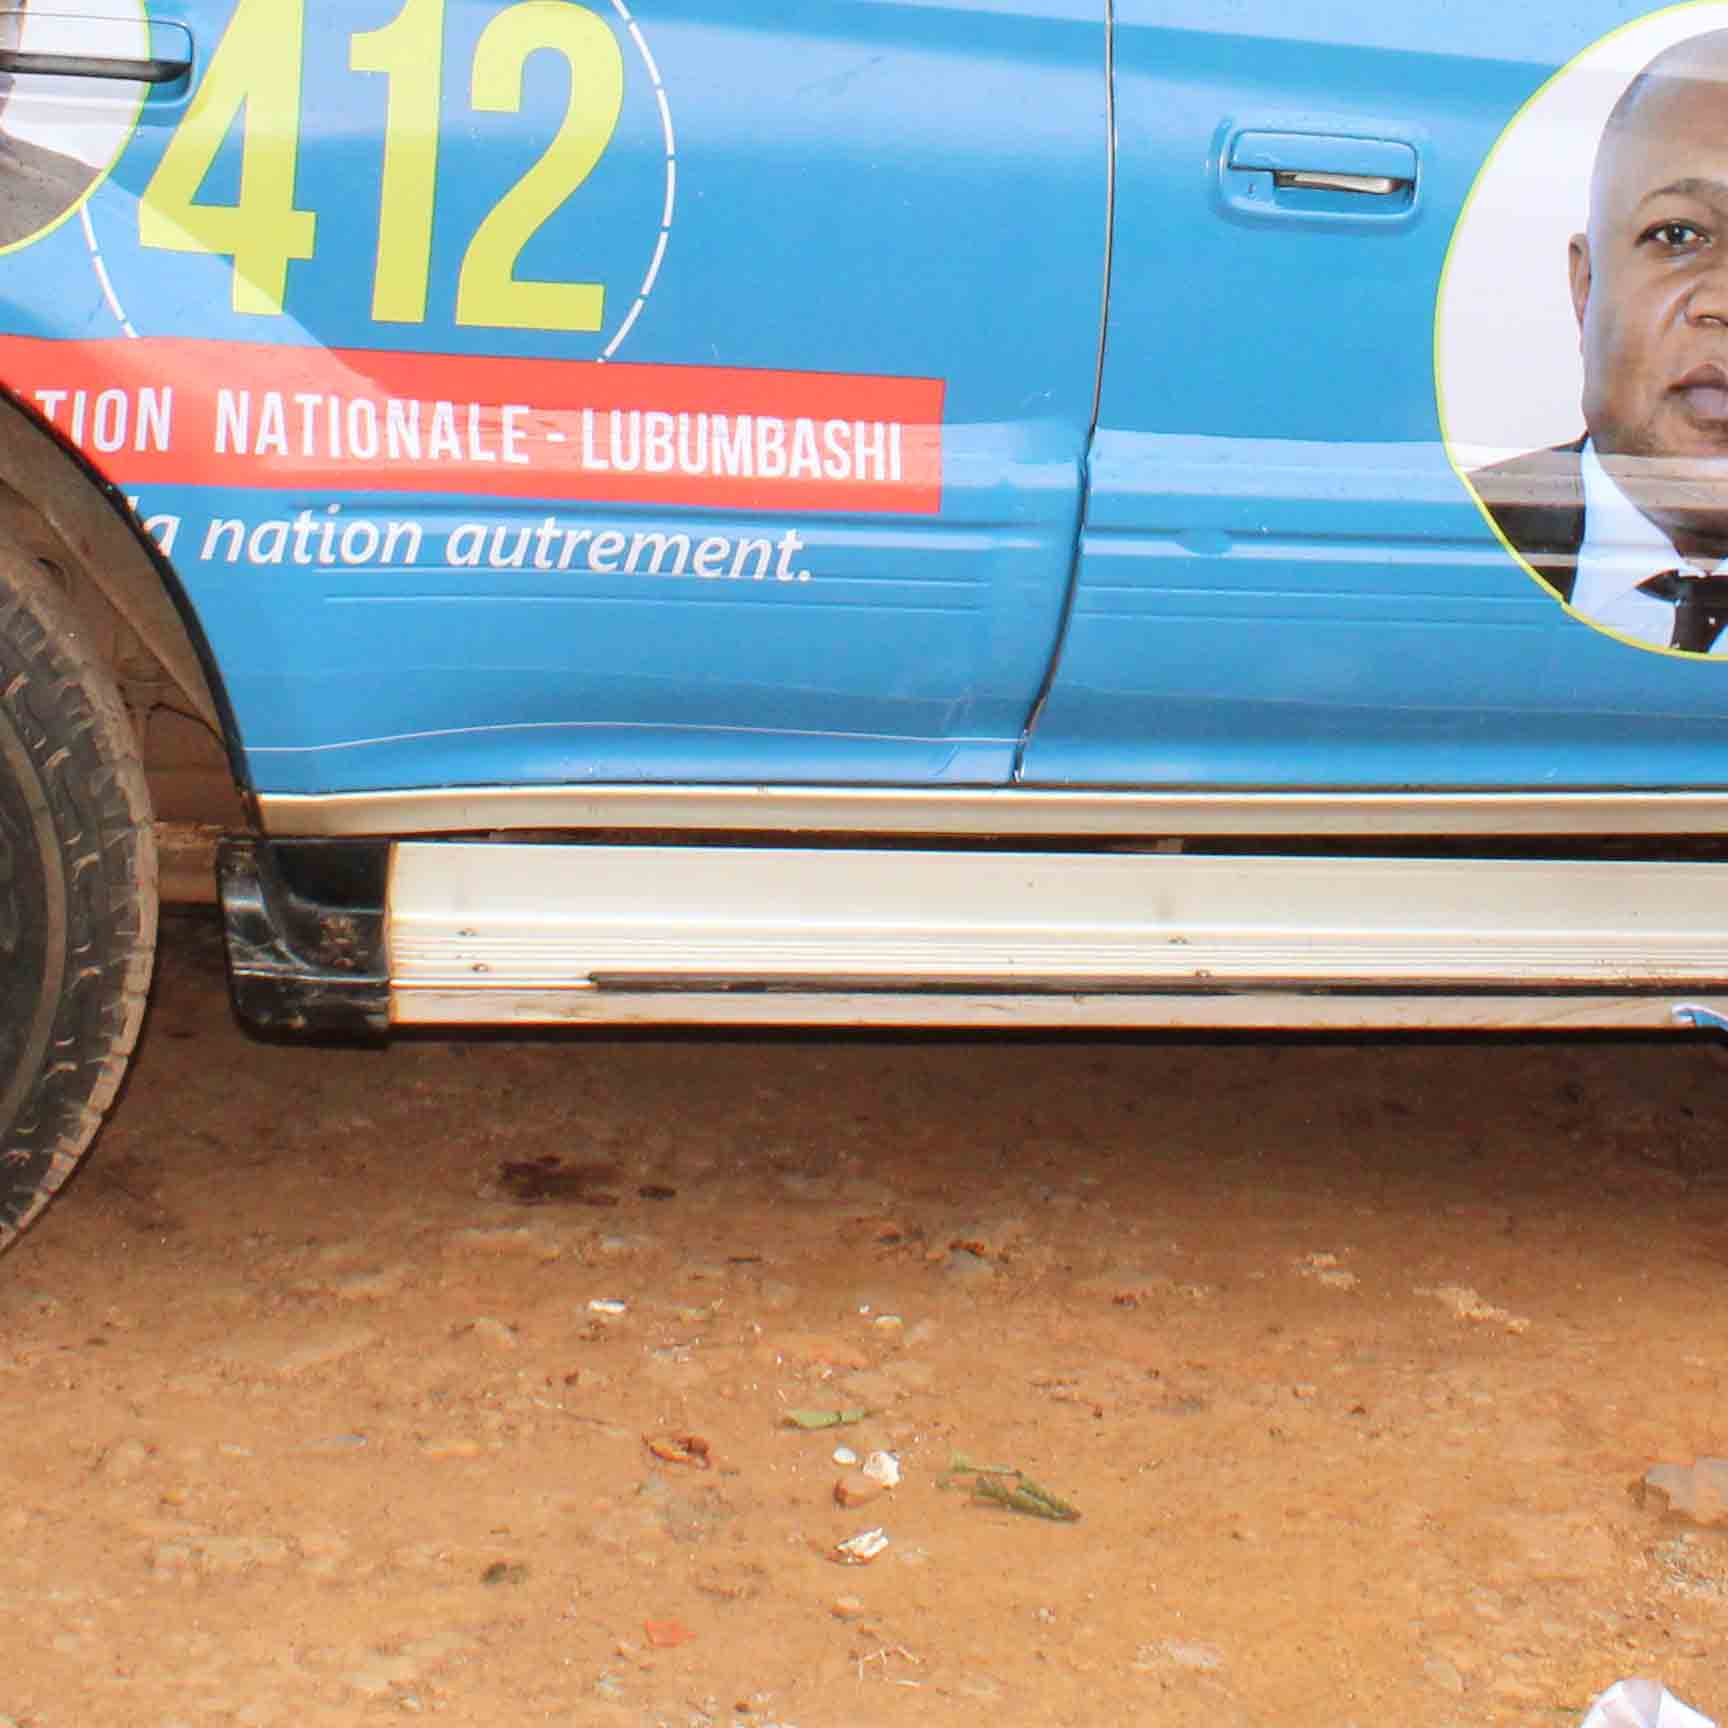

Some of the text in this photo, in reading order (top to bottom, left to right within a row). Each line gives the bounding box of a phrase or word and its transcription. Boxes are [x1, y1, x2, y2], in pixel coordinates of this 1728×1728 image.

[216, 393, 529, 469] NATIONALE
[581, 409, 905, 483] LUBUMBASHI
[199, 507, 423, 566] nation
[446, 517, 813, 584] autrement.
